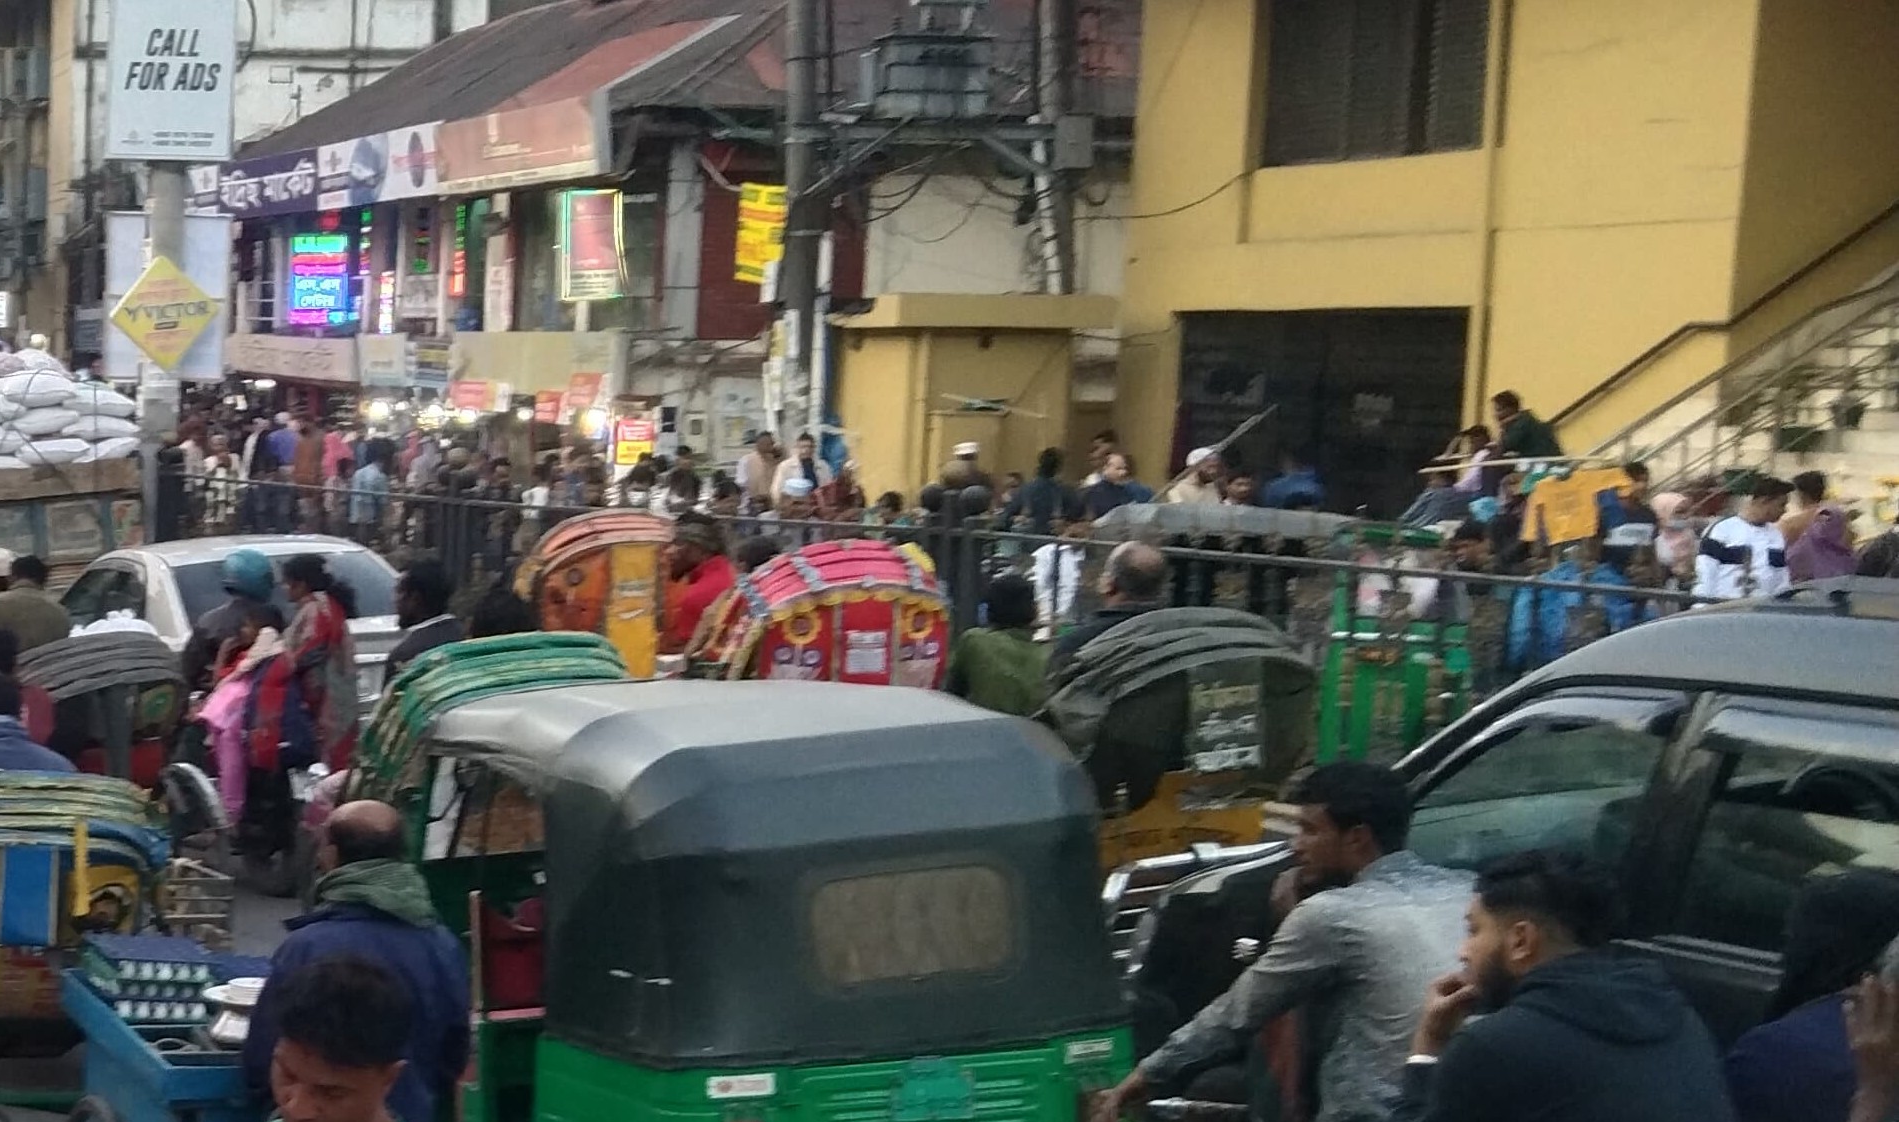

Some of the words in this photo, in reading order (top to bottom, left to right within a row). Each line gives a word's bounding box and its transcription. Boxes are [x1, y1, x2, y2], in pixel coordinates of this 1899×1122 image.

[145, 28, 200, 57] CALL
[124, 62, 170, 91] FOR
[172, 63, 221, 92] ADS
